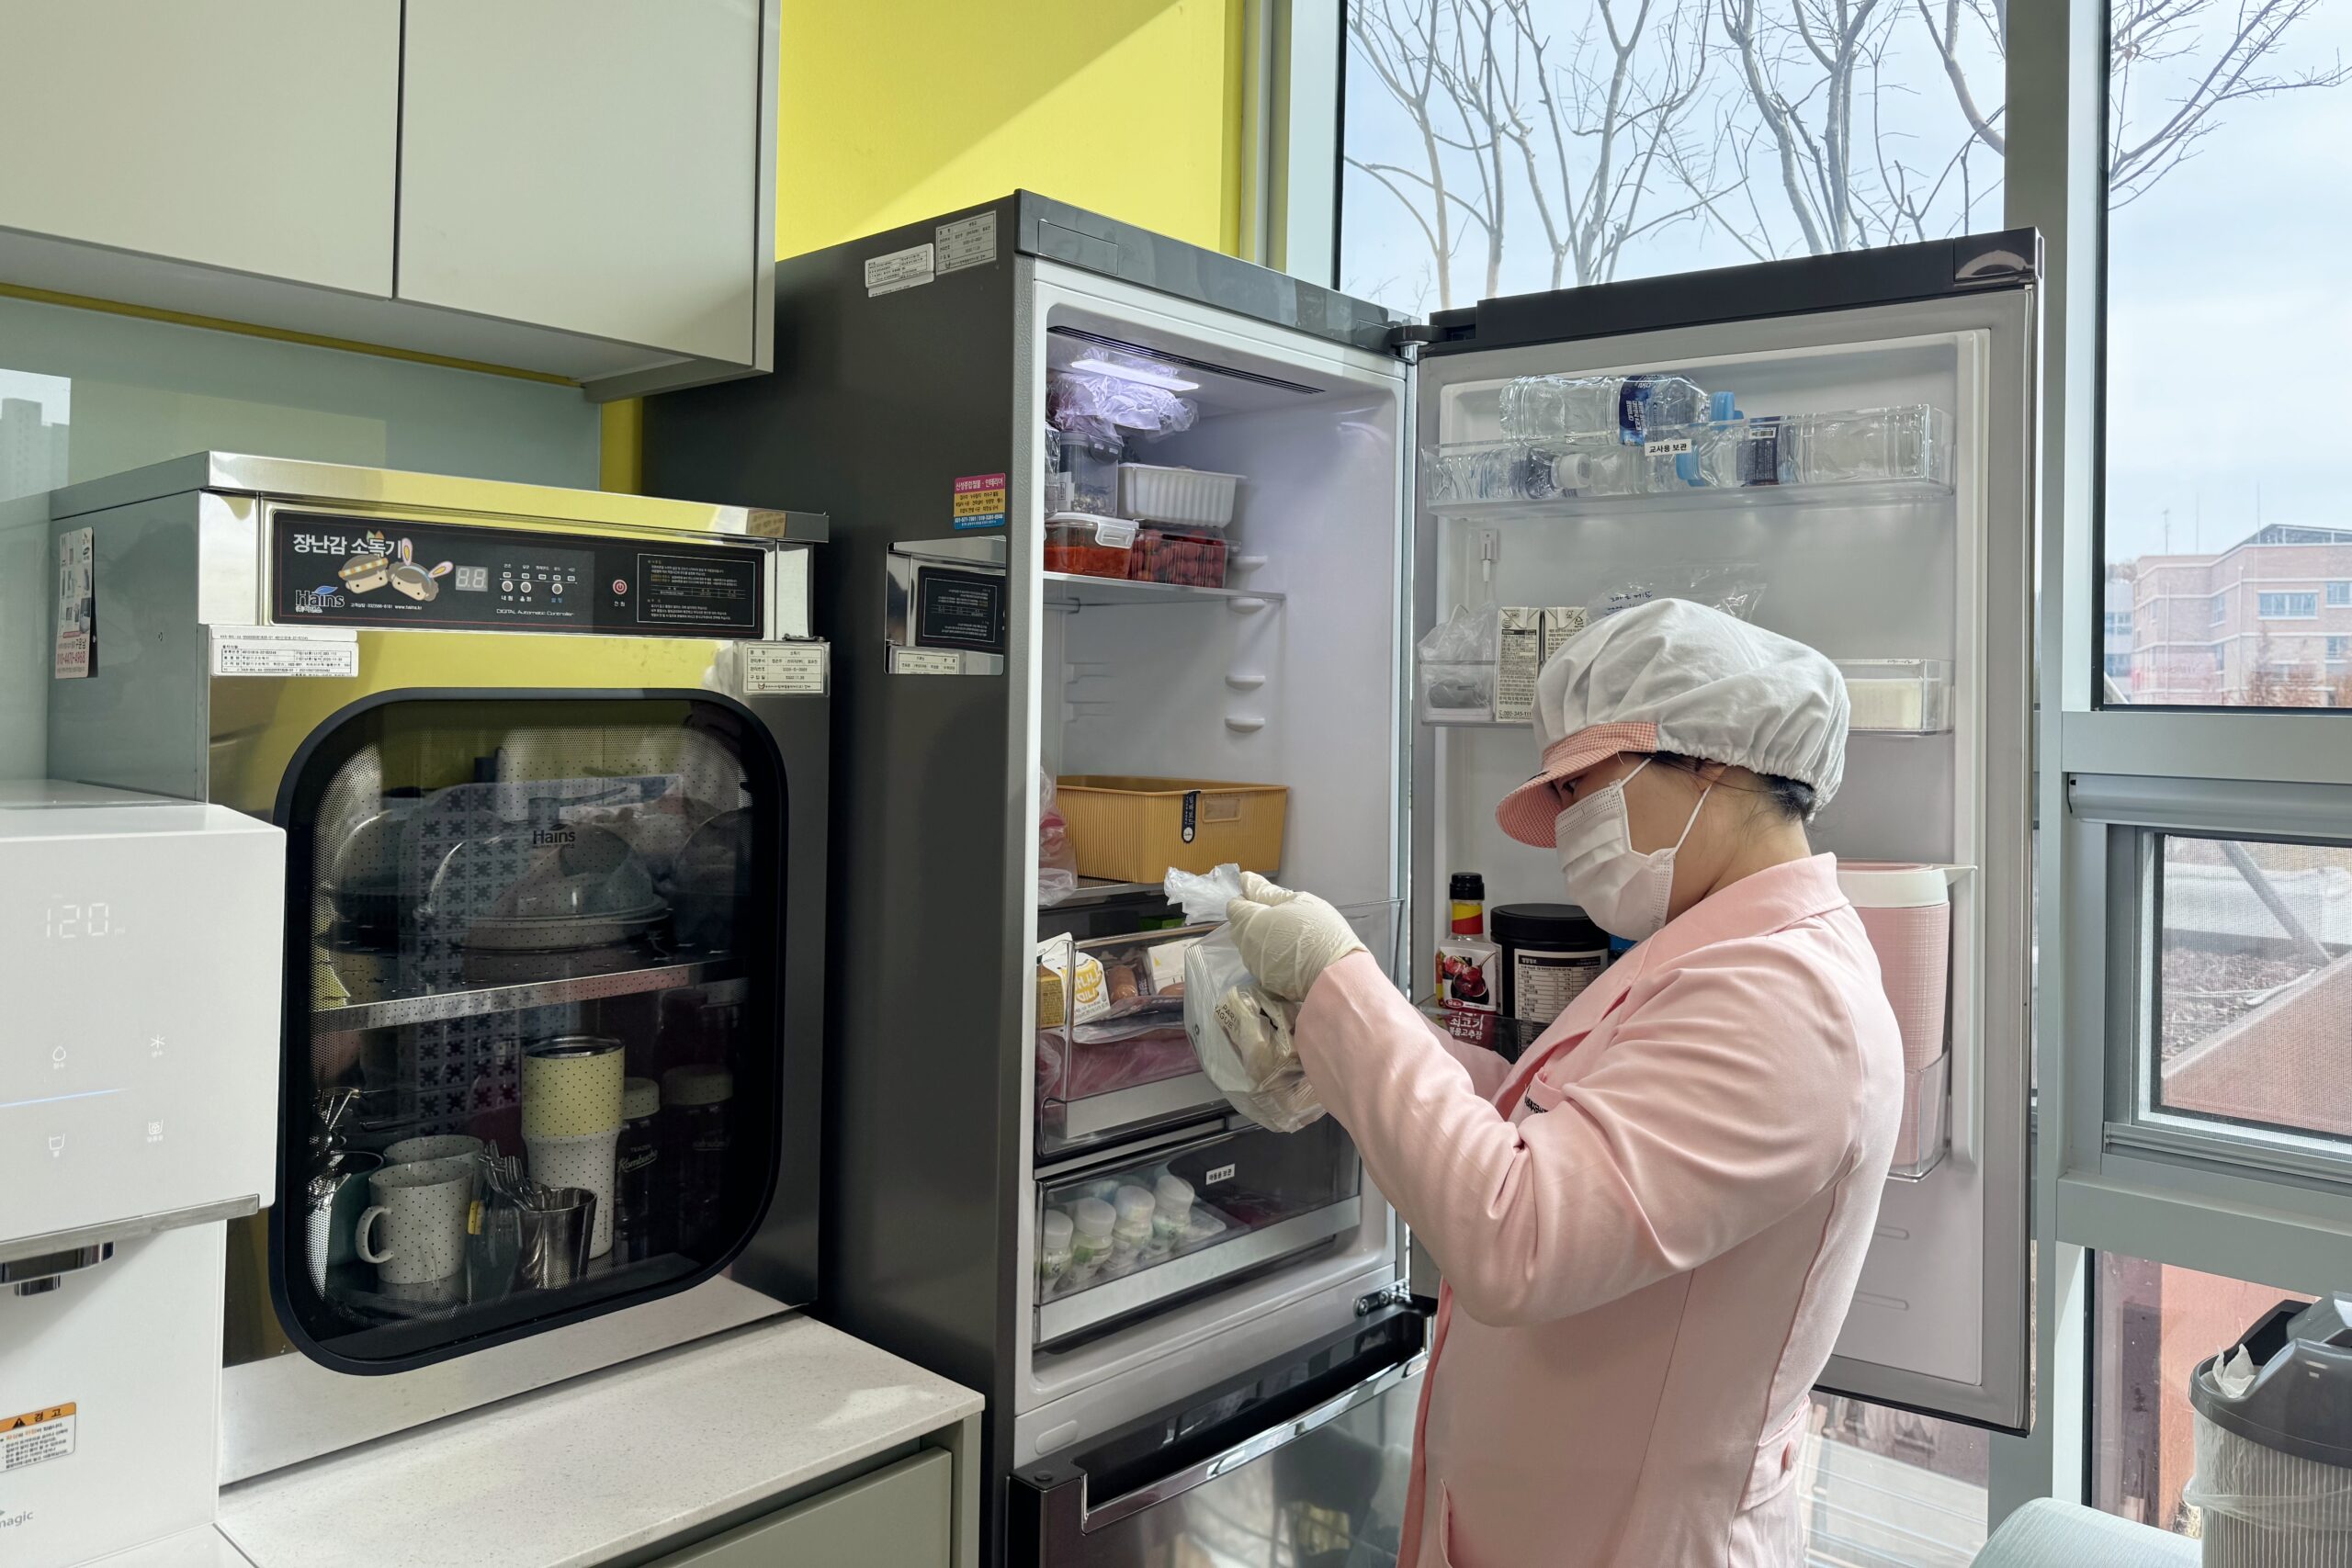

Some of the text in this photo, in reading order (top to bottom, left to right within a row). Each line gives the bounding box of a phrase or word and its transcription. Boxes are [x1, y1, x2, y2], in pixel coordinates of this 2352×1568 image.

[1649, 443, 1687, 453] 교사용 보관
[292, 534, 402, 559] 장난감 소독기
[295, 590, 345, 608] Hains
[533, 829, 576, 844] Hains
[47, 903, 108, 938] 120
[1215, 1003, 1233, 1029] AGUE
[1222, 1004, 1237, 1022] PARI
[1450, 1014, 1485, 1031] 쇠고기
